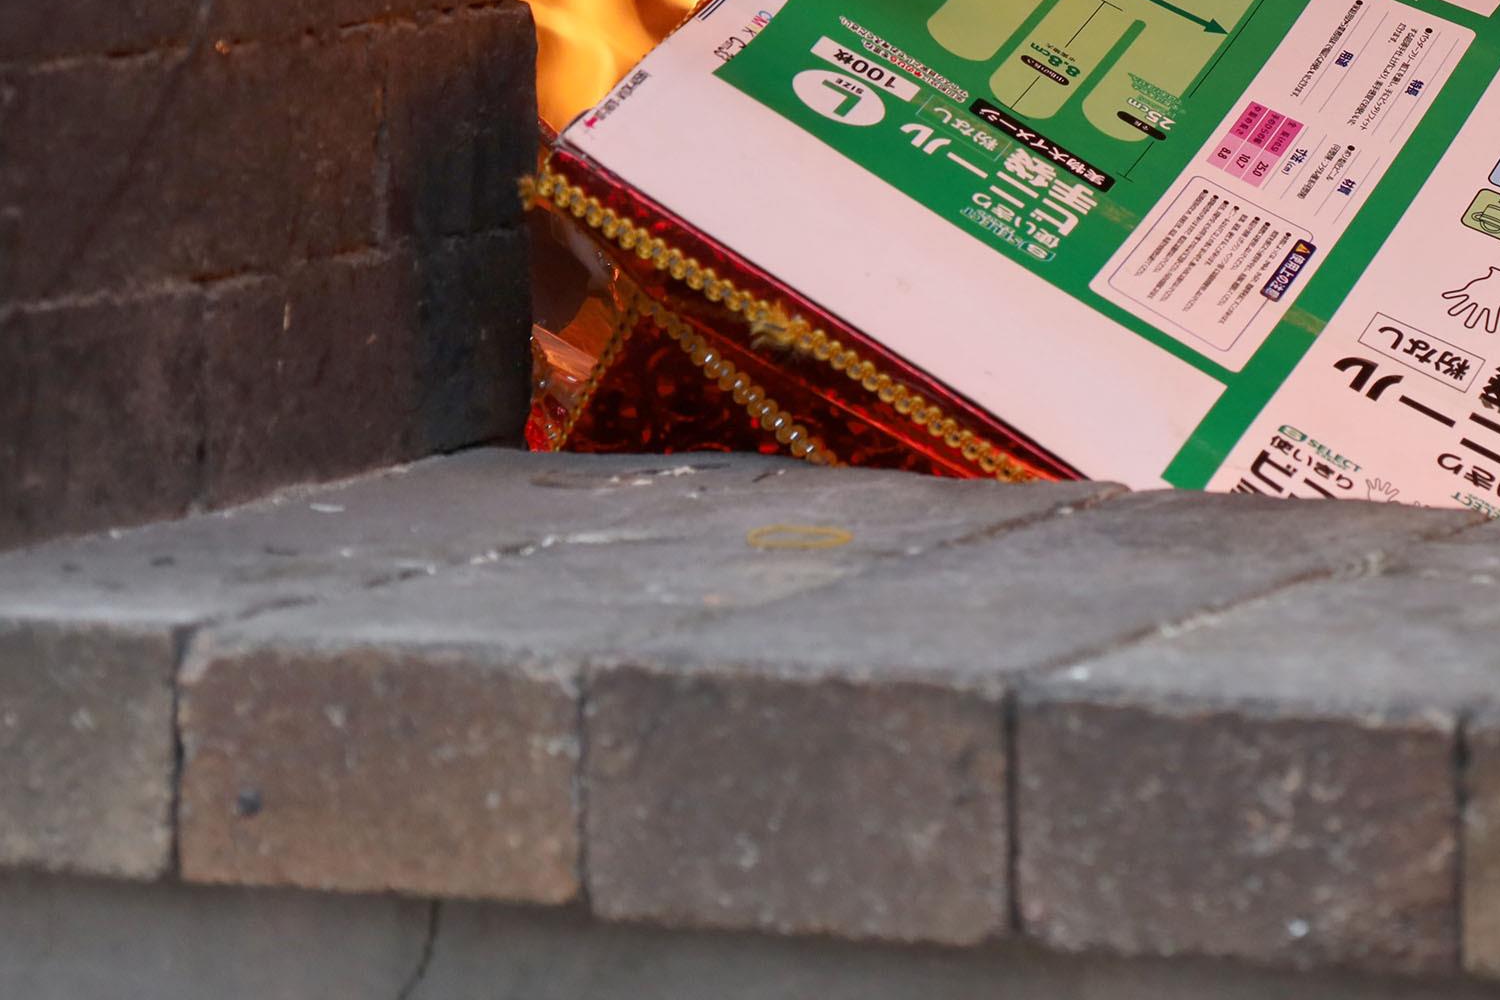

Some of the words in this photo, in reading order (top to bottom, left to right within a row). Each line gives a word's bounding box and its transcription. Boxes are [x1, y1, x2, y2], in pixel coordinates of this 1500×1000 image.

[831, 47, 900, 89] 100枚
[1027, 42, 1082, 77] 8.8cm
[1333, 49, 1354, 68] 用途
[821, 79, 861, 117] L
[834, 77, 864, 94] SIZE
[1403, 78, 1424, 97] 特長
[928, 105, 1000, 152] 粉なし
[1124, 97, 1176, 130] 25cm
[977, 105, 1106, 185] 実物大イメージ
[1217, 147, 1231, 159] 8.8
[1233, 153, 1250, 168] 10.7
[893, 117, 1082, 236] ビニール
[998, 145, 1104, 216] 手袋
[1251, 160, 1268, 177] 25.0
[1336, 177, 1356, 195] 材質
[968, 190, 1062, 249] 使いきり
[1373, 322, 1471, 381] 粉なし
[1270, 436, 1353, 489] 使いきり
[1307, 439, 1362, 472] SELECT
